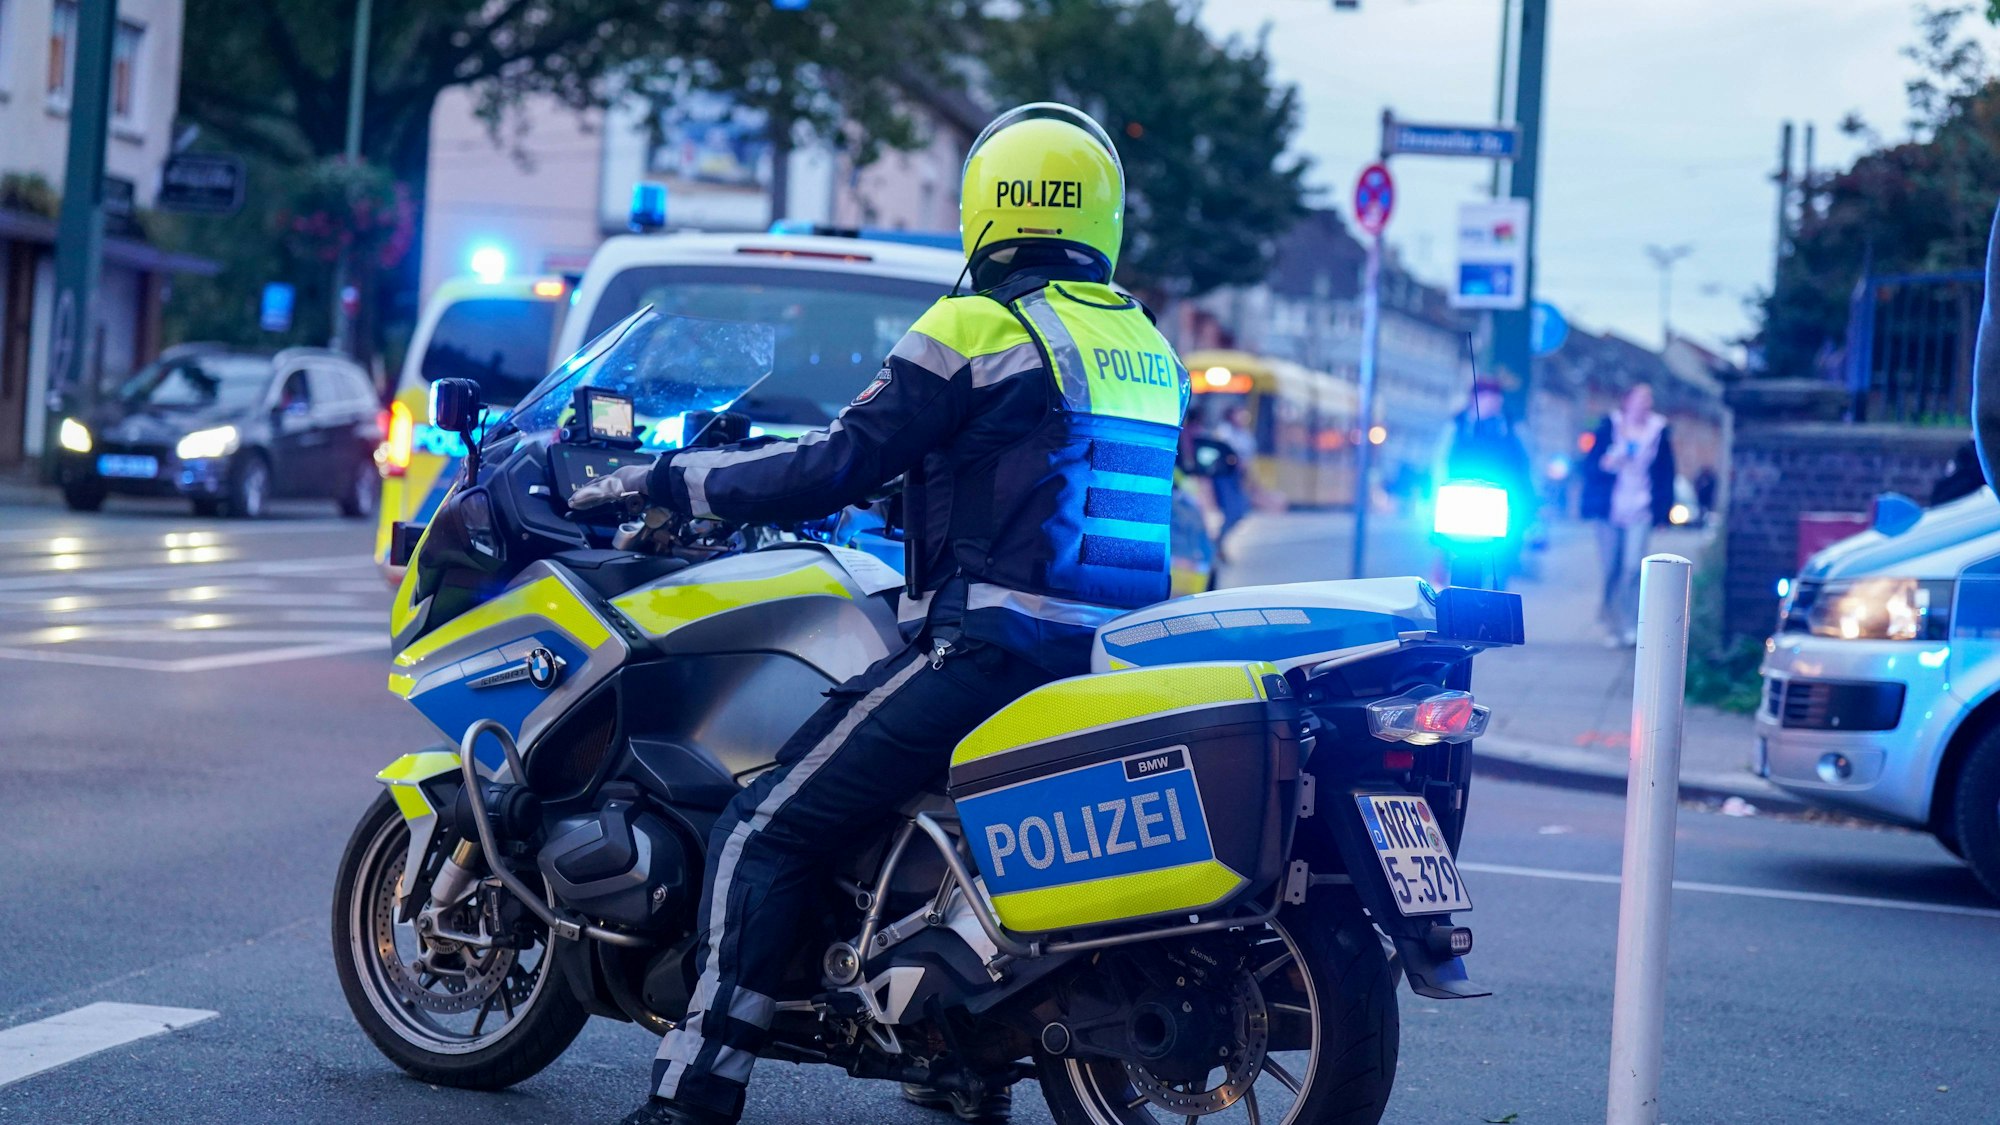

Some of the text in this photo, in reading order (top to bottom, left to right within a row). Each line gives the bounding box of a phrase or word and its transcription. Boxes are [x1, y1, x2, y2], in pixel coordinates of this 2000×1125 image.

[997, 180, 1082, 209] POLIZEI
[1092, 348, 1172, 389] POLIZEI
[1138, 756, 1169, 773] BMW
[985, 788, 1186, 877] POLIZEI
[1373, 829, 1382, 844] D
[1375, 801, 1430, 849] NRW
[1190, 946, 1218, 966] brembo
